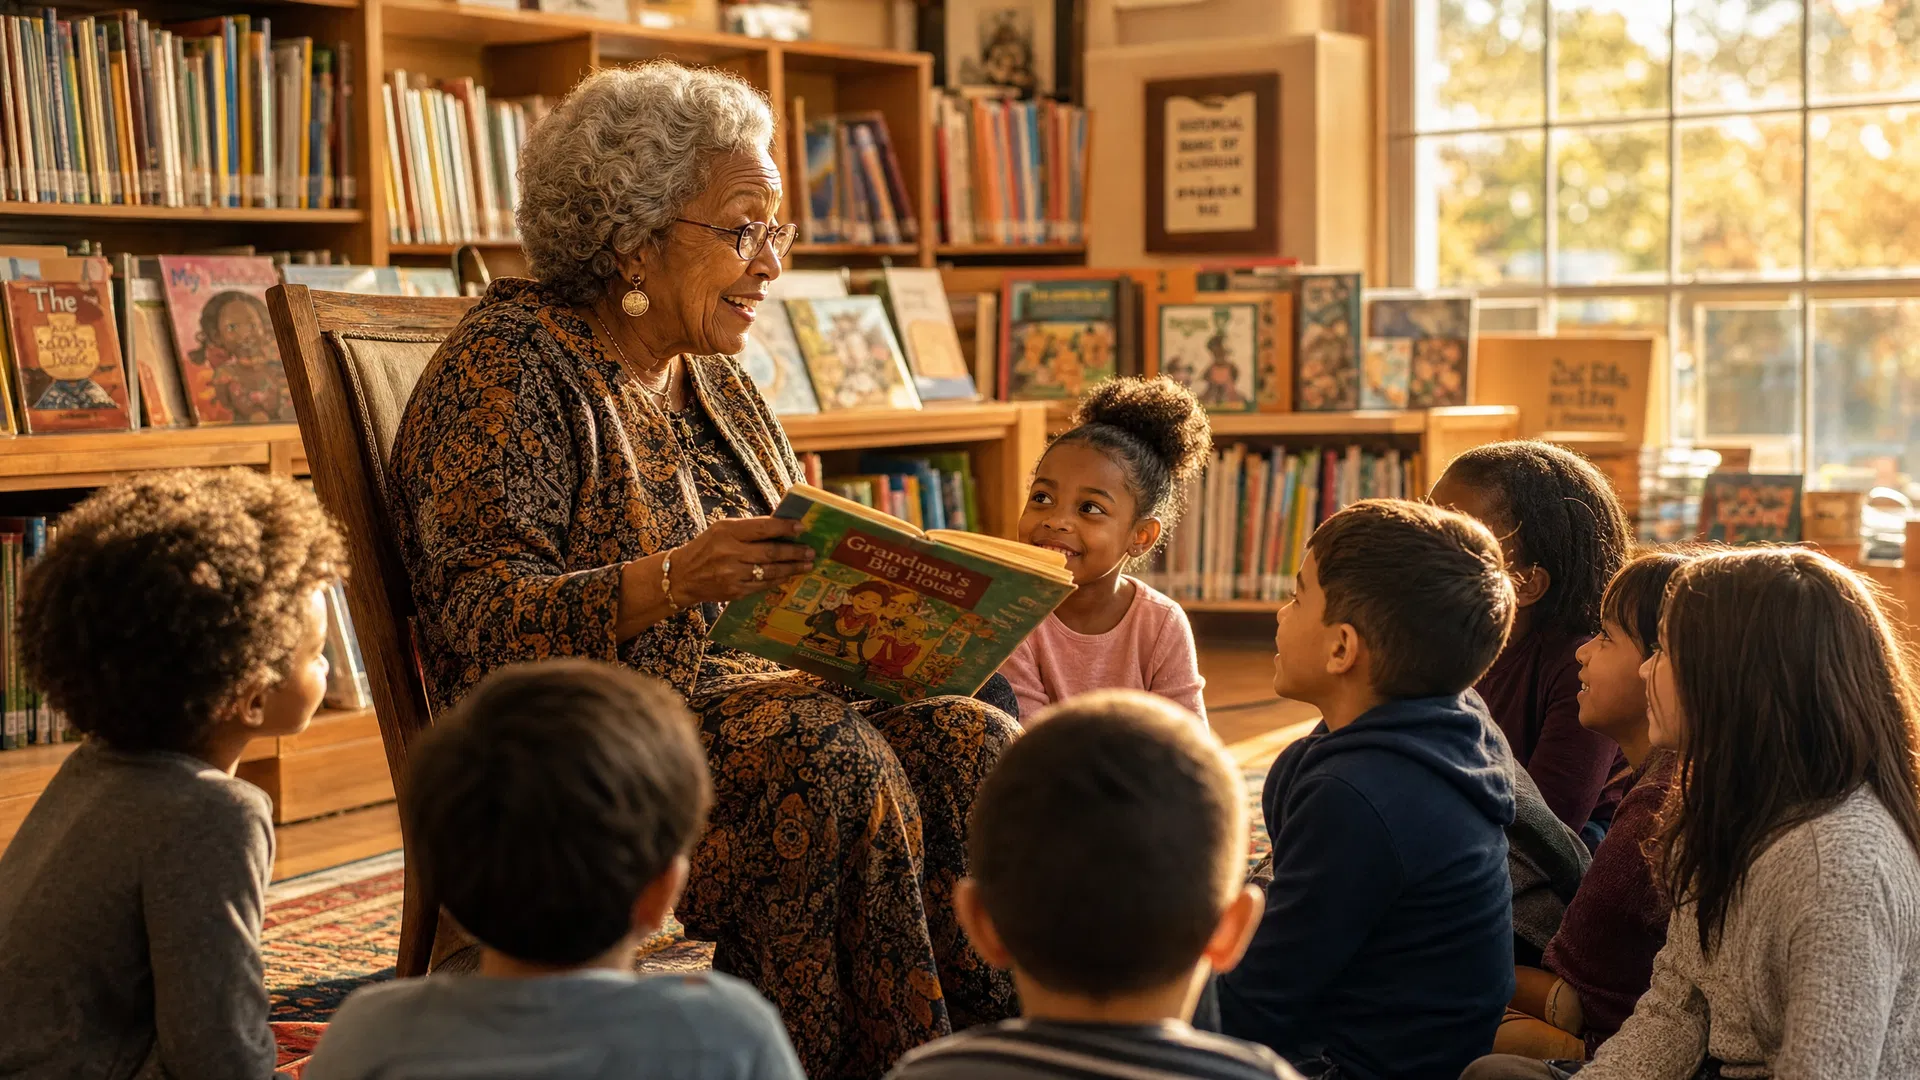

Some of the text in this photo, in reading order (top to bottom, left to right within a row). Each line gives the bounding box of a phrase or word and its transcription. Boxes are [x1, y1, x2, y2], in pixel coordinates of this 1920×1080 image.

[28, 286, 78, 313] The
[847, 536, 972, 588] Grandma's
[867, 556, 967, 599] Big House
